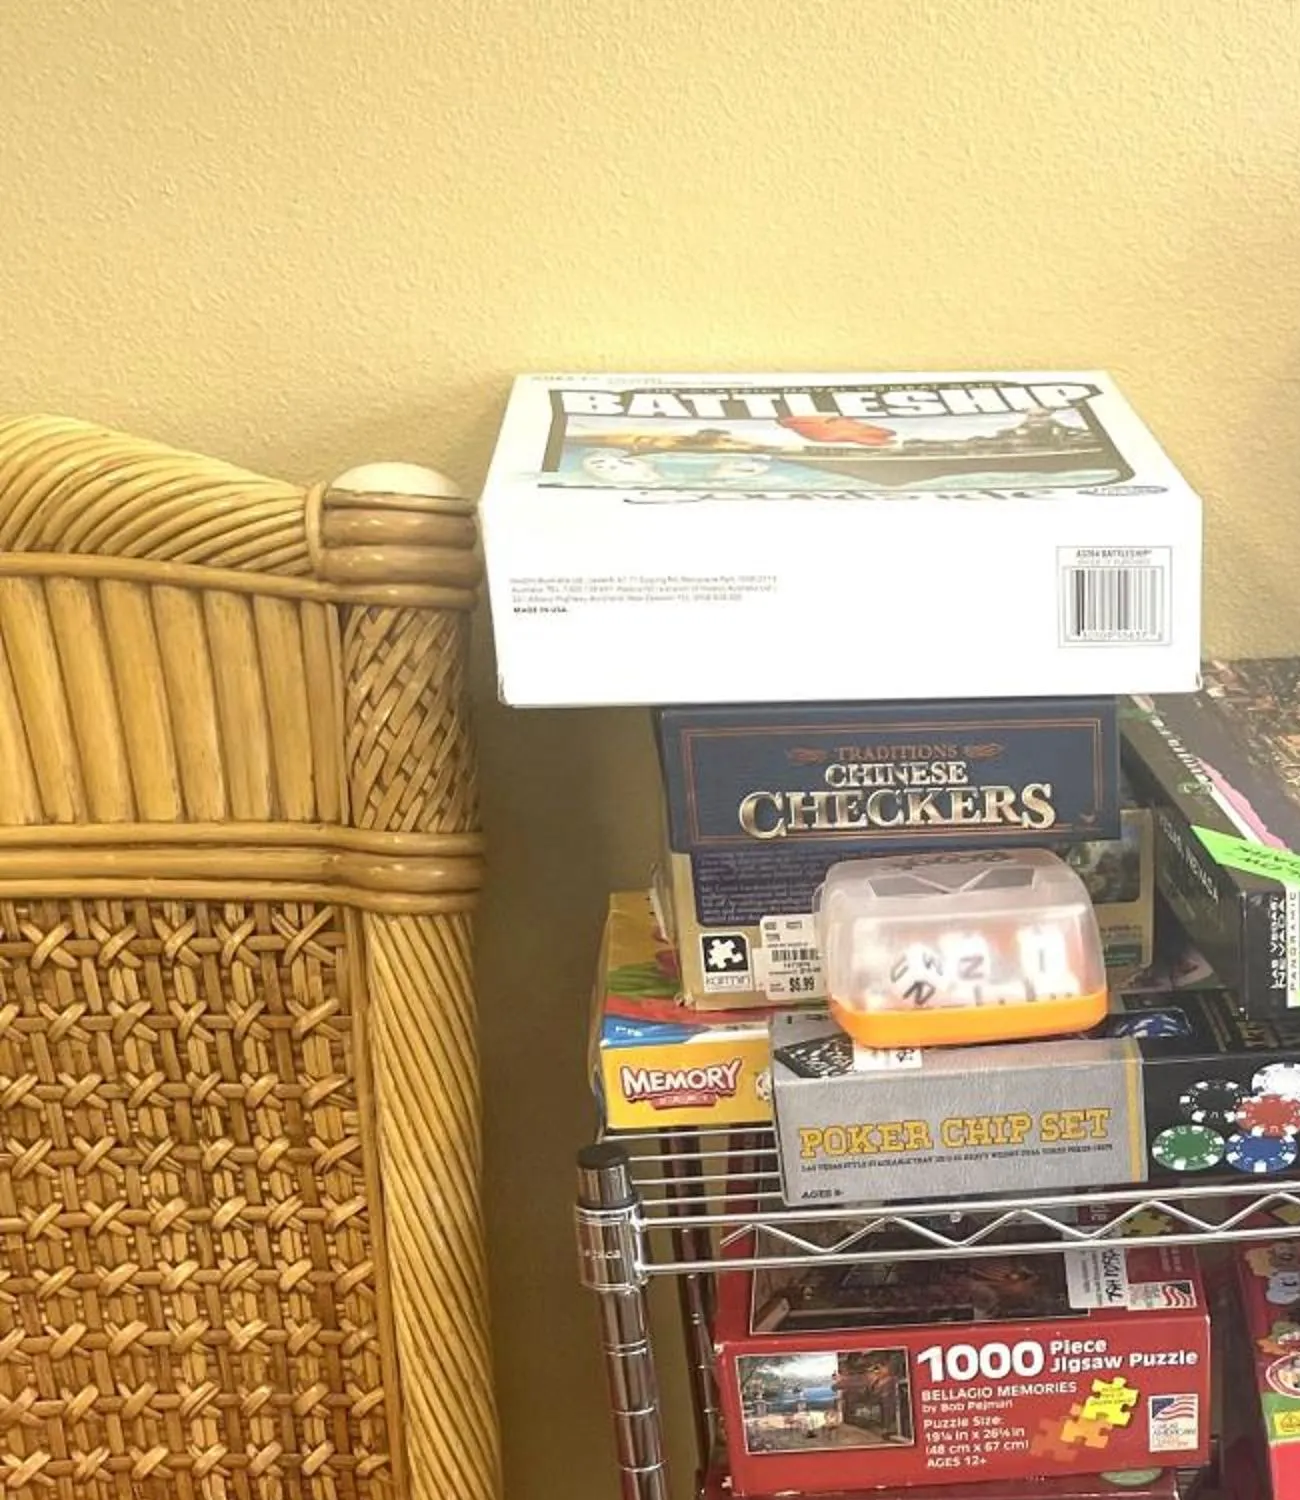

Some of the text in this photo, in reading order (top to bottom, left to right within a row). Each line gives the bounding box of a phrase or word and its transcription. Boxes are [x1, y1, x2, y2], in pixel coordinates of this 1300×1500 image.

[560, 383, 1095, 418] BATTLESHIP
[834, 743, 958, 762] TRADITIONS
[825, 761, 969, 788] CHINESE
[738, 782, 1057, 841] CHECKERS
[1289, 891, 1298, 991] PANORAMIC
[619, 1057, 743, 1099] MEMORY
[798, 1107, 1113, 1160] POKER CHIP SET
[801, 1189, 832, 1200] AGES
[915, 1338, 1107, 1384] 1000 Piece
[1049, 1350, 1198, 1375] Jigsaw Puzzle
[920, 1386, 993, 1402] BELLAGIO
[996, 1381, 1078, 1398] MEMORIES
[923, 1417, 969, 1430] Puzzle
[927, 1454, 988, 1469] AGES 12+
